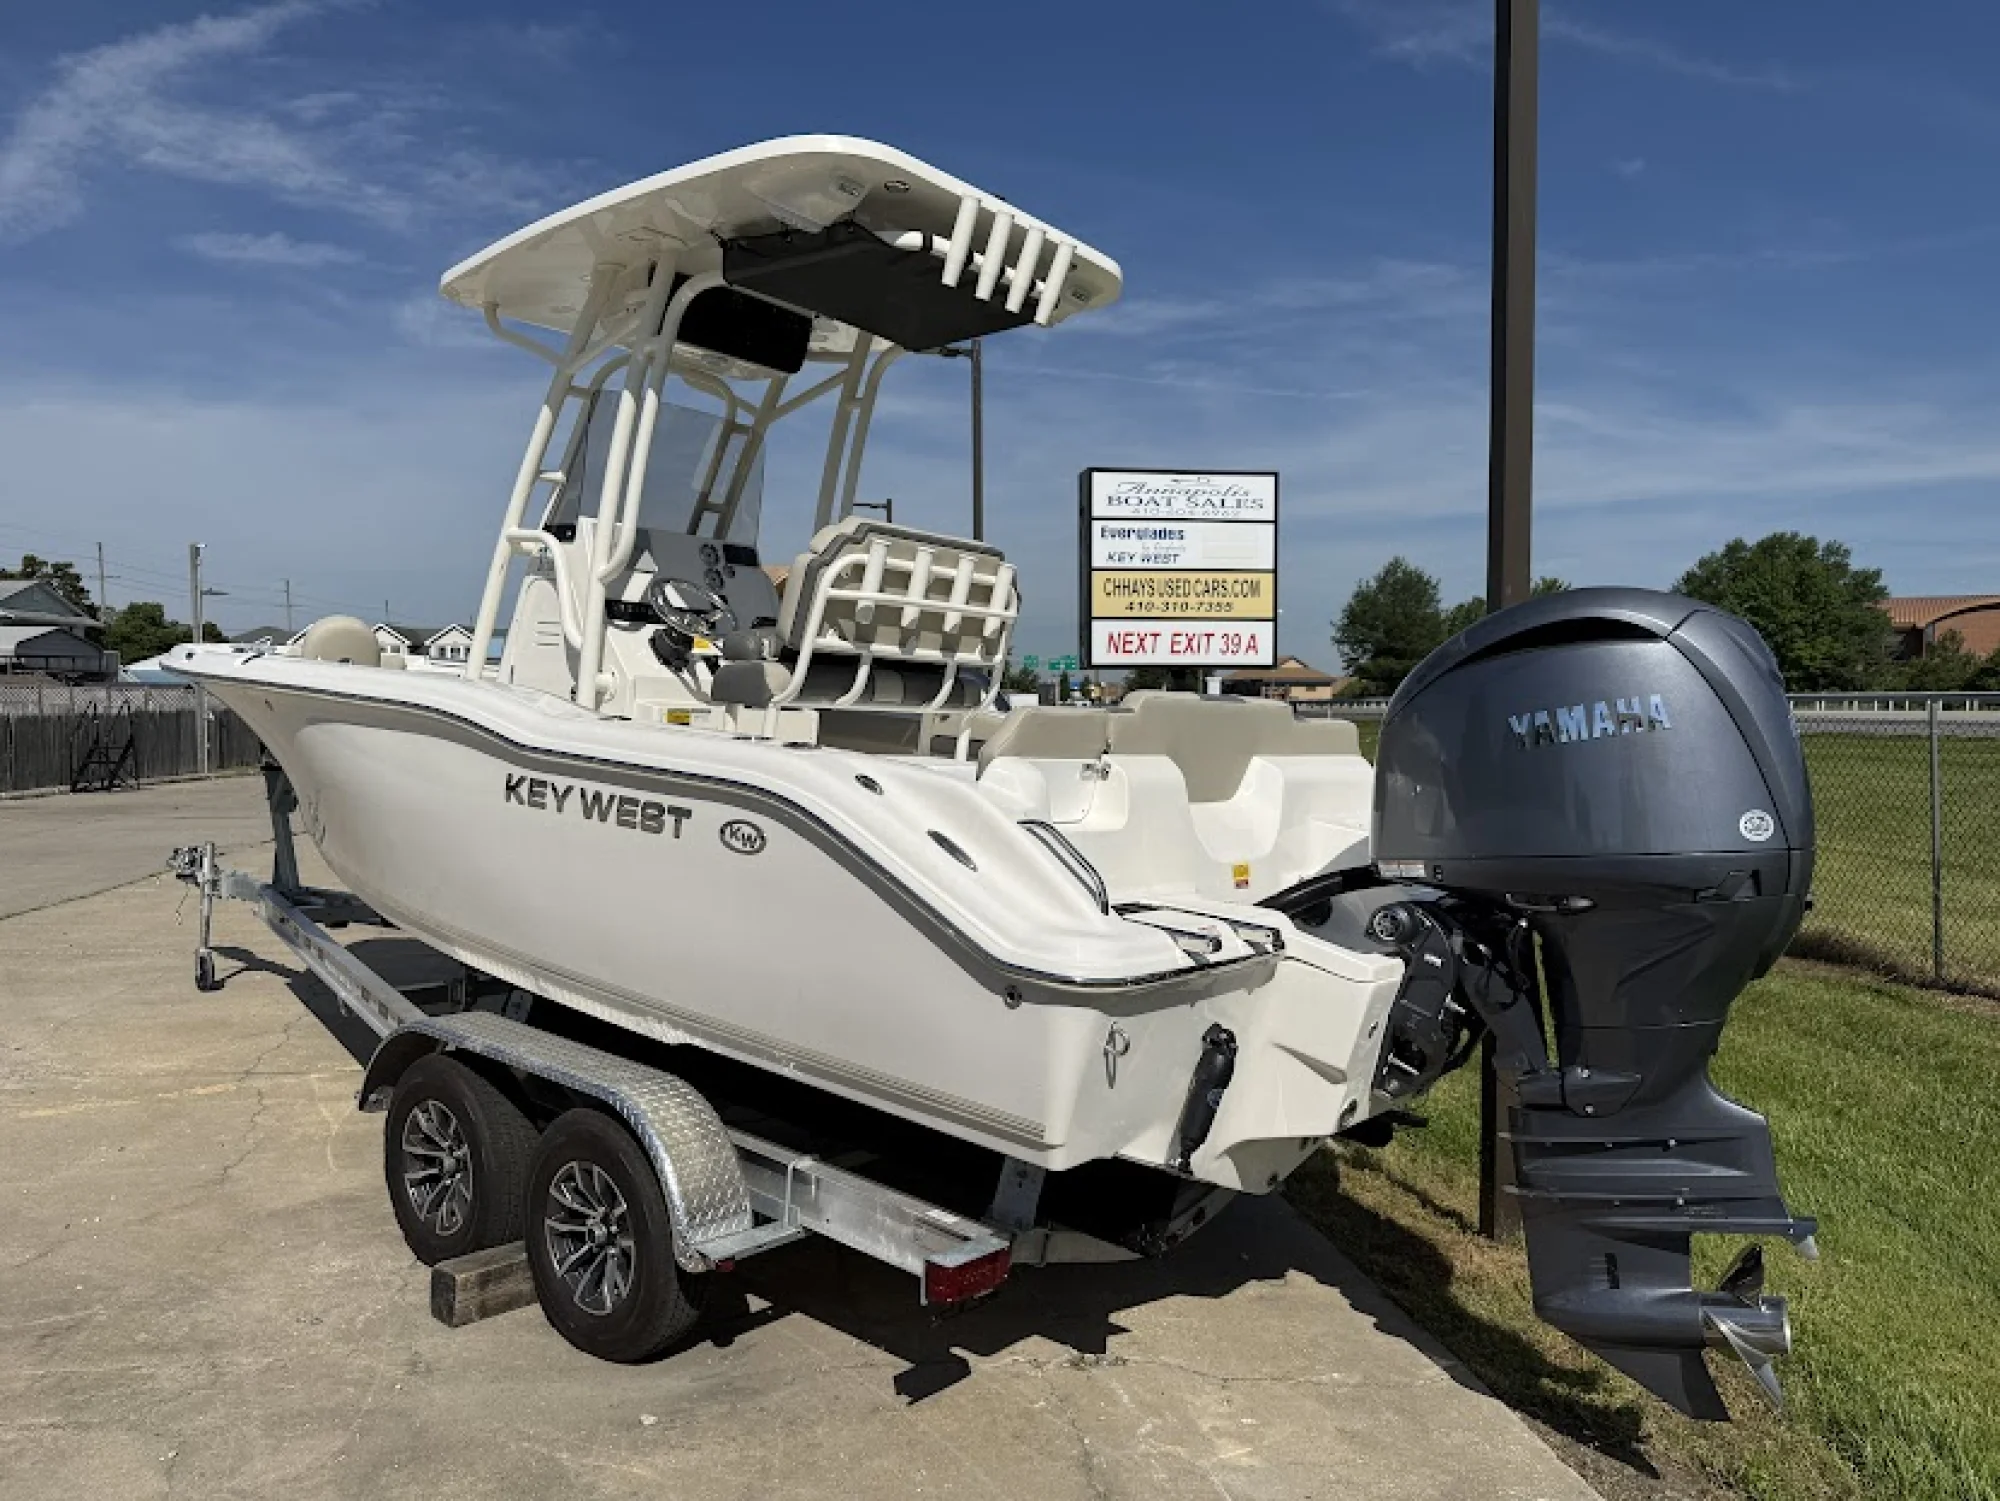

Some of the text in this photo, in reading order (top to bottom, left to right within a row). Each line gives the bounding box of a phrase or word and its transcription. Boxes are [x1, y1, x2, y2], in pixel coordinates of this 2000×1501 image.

[1106, 495, 1264, 509] BOAT SALES
[1106, 552, 1181, 565] KEY WEST
[1106, 632, 1162, 655] NEXT
[1170, 632, 1215, 656] EXIT
[1507, 693, 1673, 749] YAMAHA
[505, 772, 693, 839] KEY WEST
